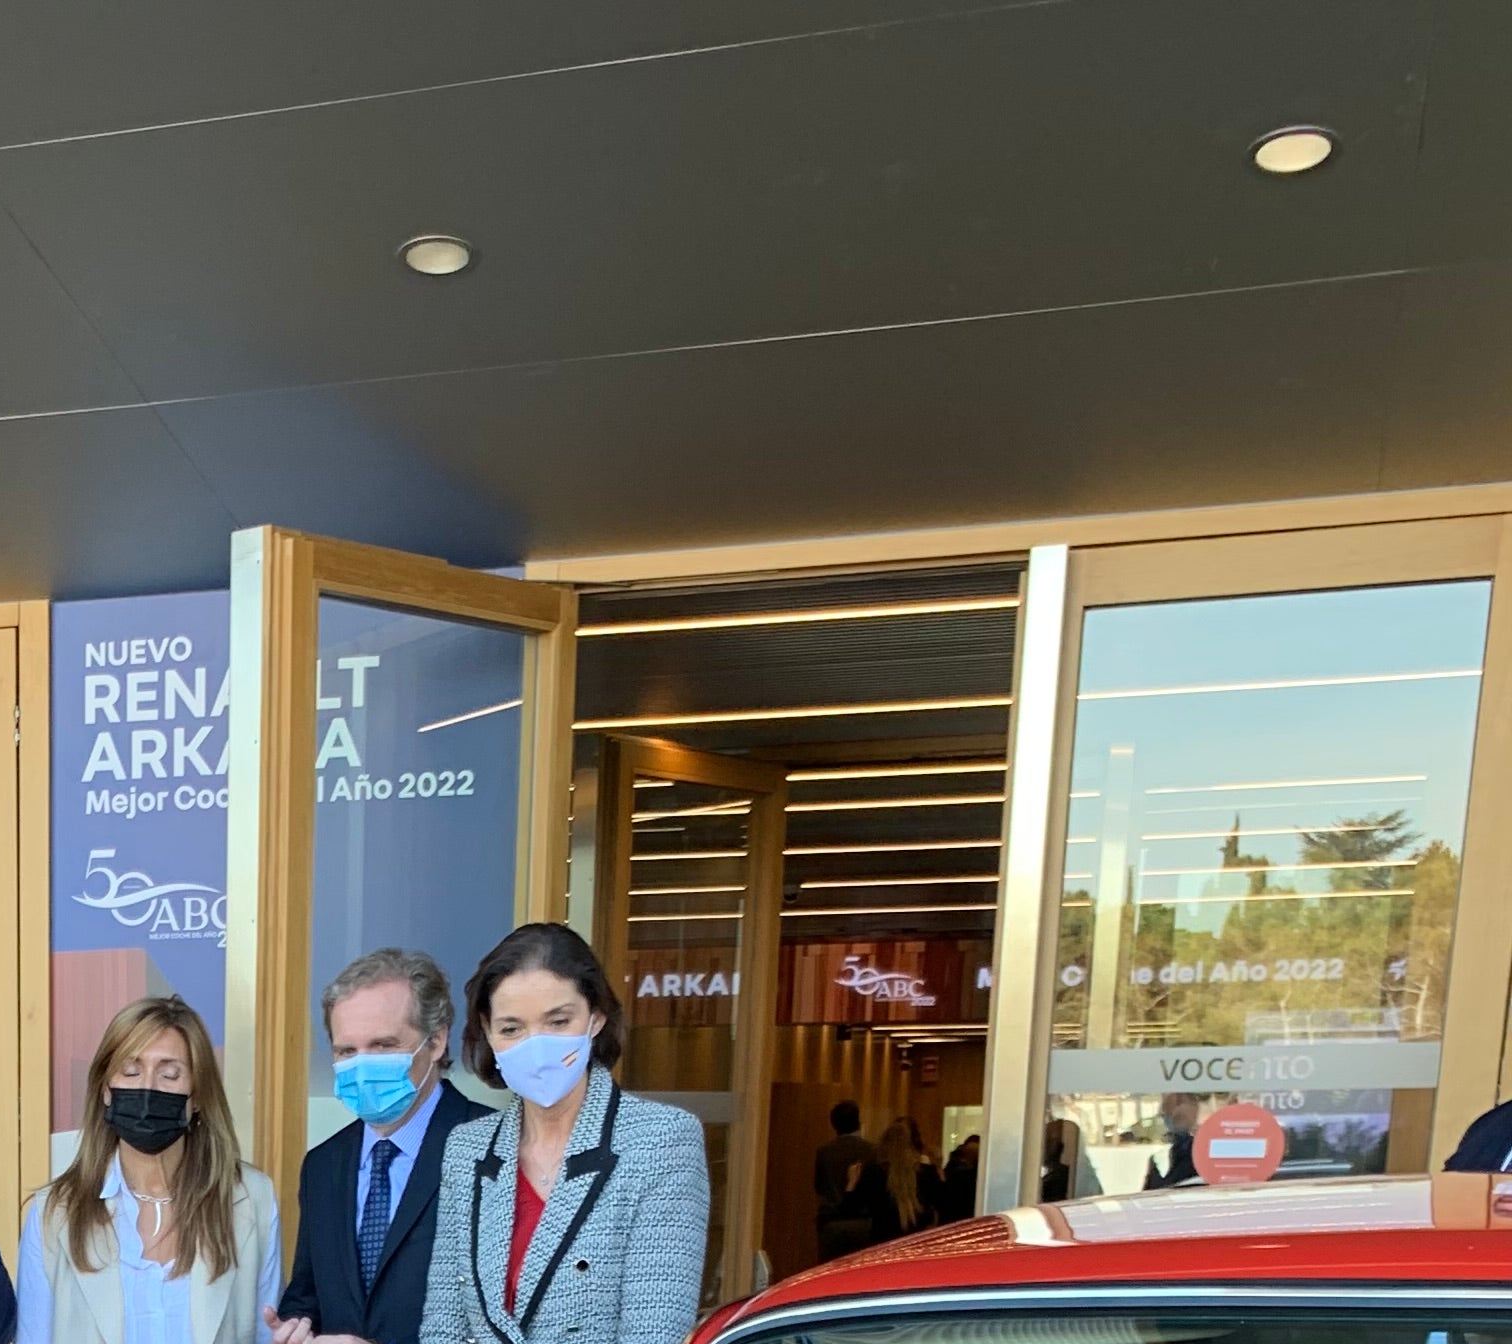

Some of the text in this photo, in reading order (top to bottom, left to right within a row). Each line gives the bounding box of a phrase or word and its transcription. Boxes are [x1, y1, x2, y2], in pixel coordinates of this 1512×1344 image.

[85, 636, 192, 667] NUEVO
[85, 786, 169, 819] Mejor
[330, 774, 393, 802] Año
[398, 770, 474, 798] 2022
[1158, 961, 1203, 984] del
[1208, 959, 1268, 983] Año
[1273, 957, 1344, 982] 2022
[875, 979, 925, 999] ABC
